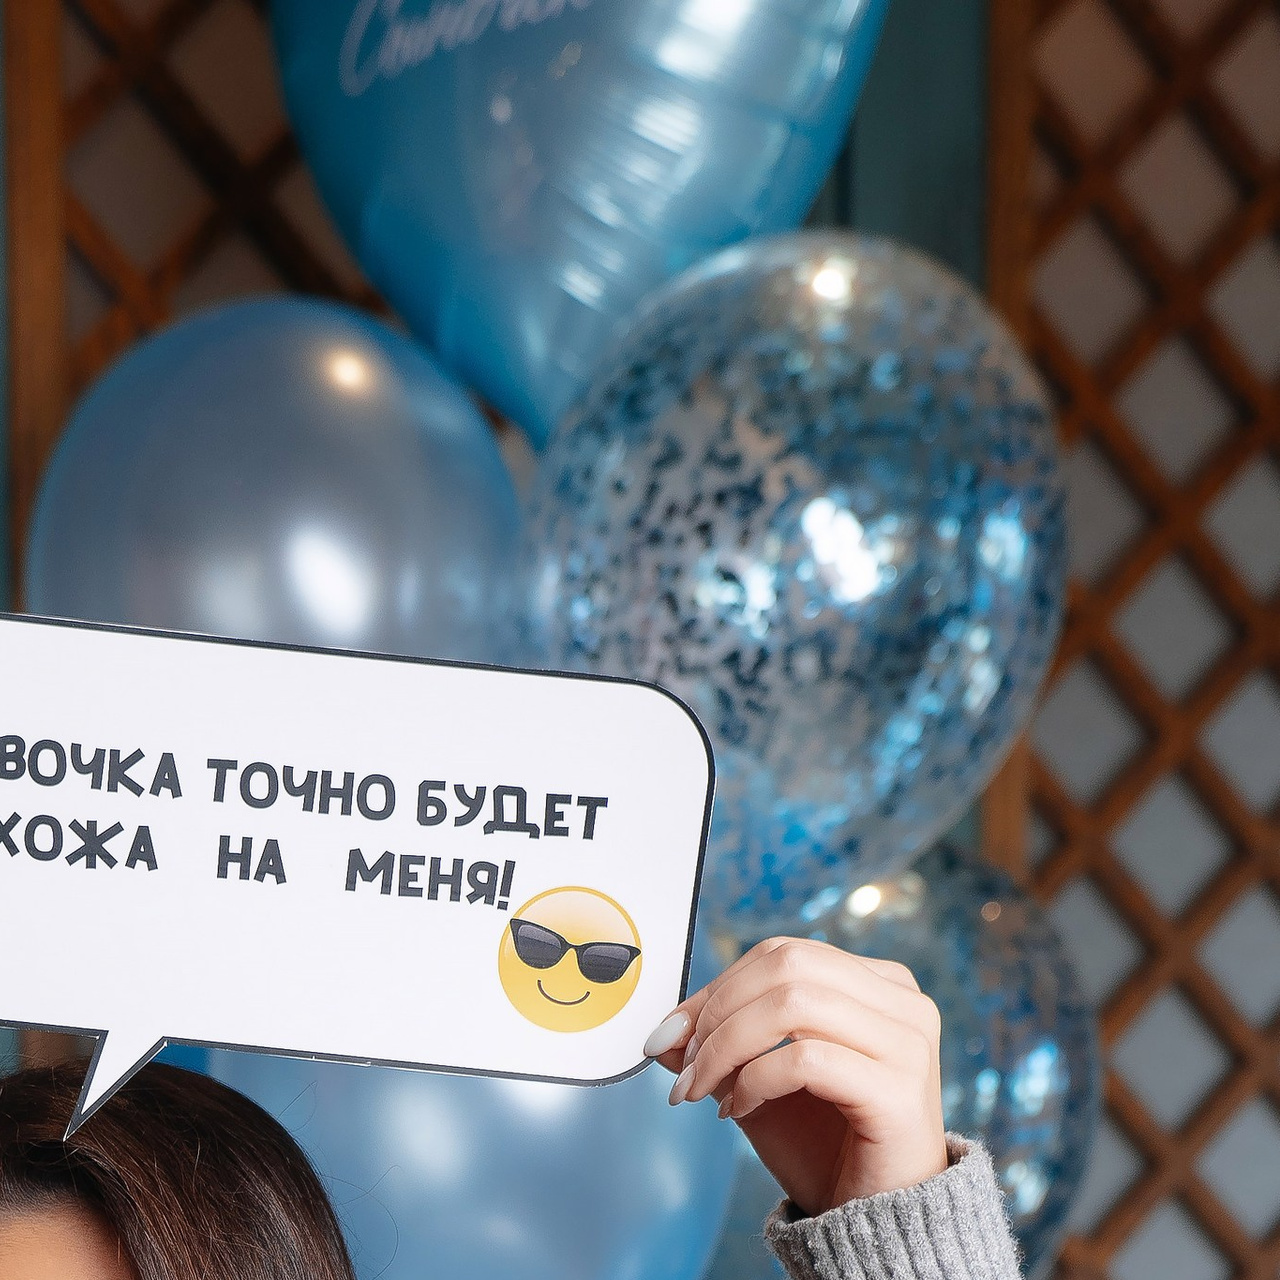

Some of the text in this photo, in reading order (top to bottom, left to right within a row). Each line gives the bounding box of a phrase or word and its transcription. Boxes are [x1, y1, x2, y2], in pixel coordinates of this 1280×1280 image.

[206, 758, 396, 821] ТОЧНО
[416, 779, 609, 841] БУДЕТ
[216, 834, 287, 886] НА
[344, 847, 516, 911] МЕНЯ!
